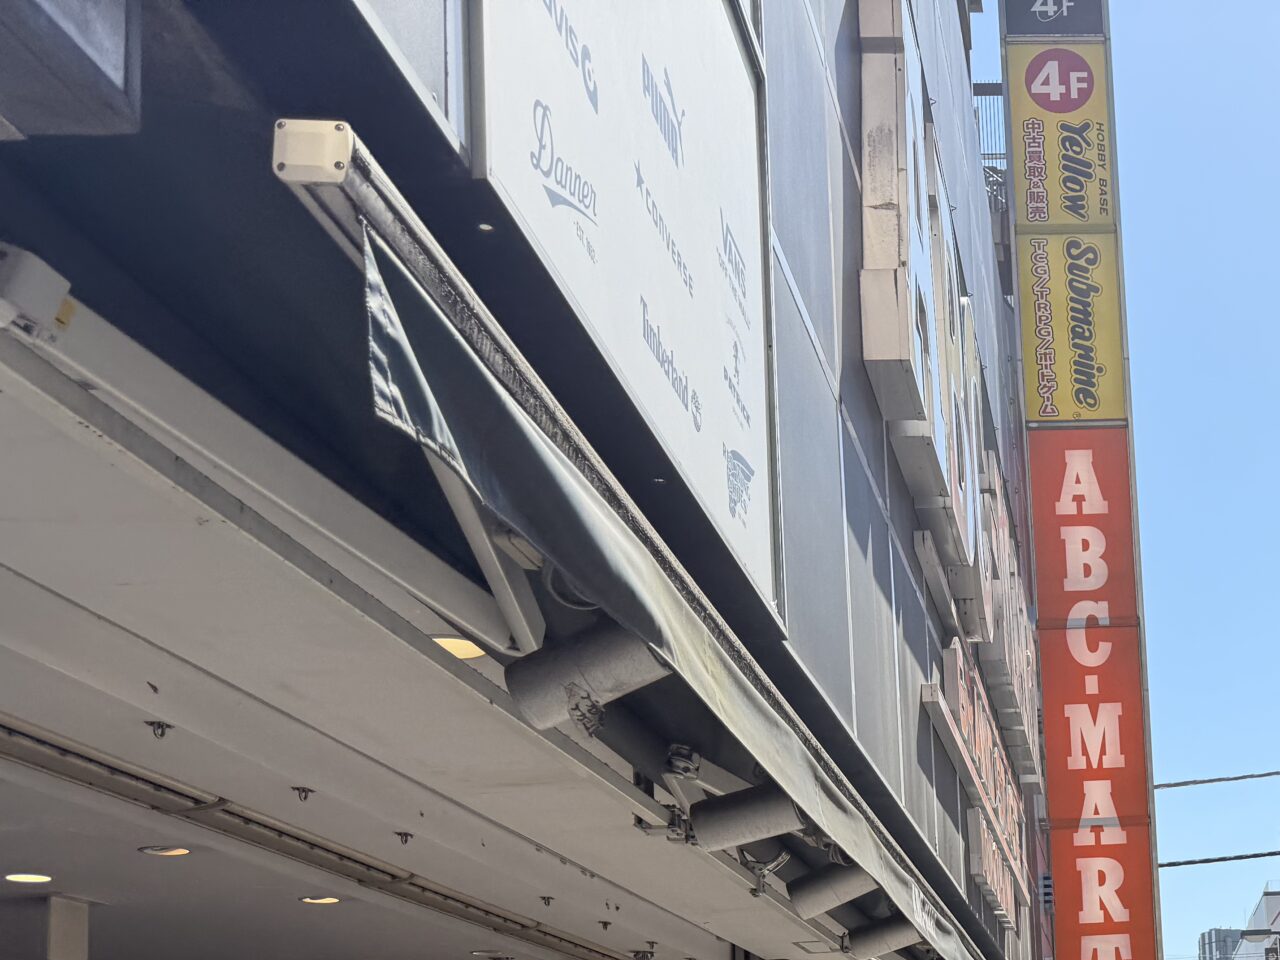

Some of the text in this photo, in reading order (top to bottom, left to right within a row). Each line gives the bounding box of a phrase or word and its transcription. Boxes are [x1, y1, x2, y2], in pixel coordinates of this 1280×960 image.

[1030, 60, 1089, 101] 4F
[530, 98, 597, 217] Danner
[1057, 119, 1092, 222] Yellow
[1095, 121, 1109, 217] HOBBY BASE
[645, 190, 694, 299] CONVERSE
[720, 205, 747, 300] VANS
[640, 293, 689, 412] Timberland
[1063, 236, 1105, 411] Submarine
